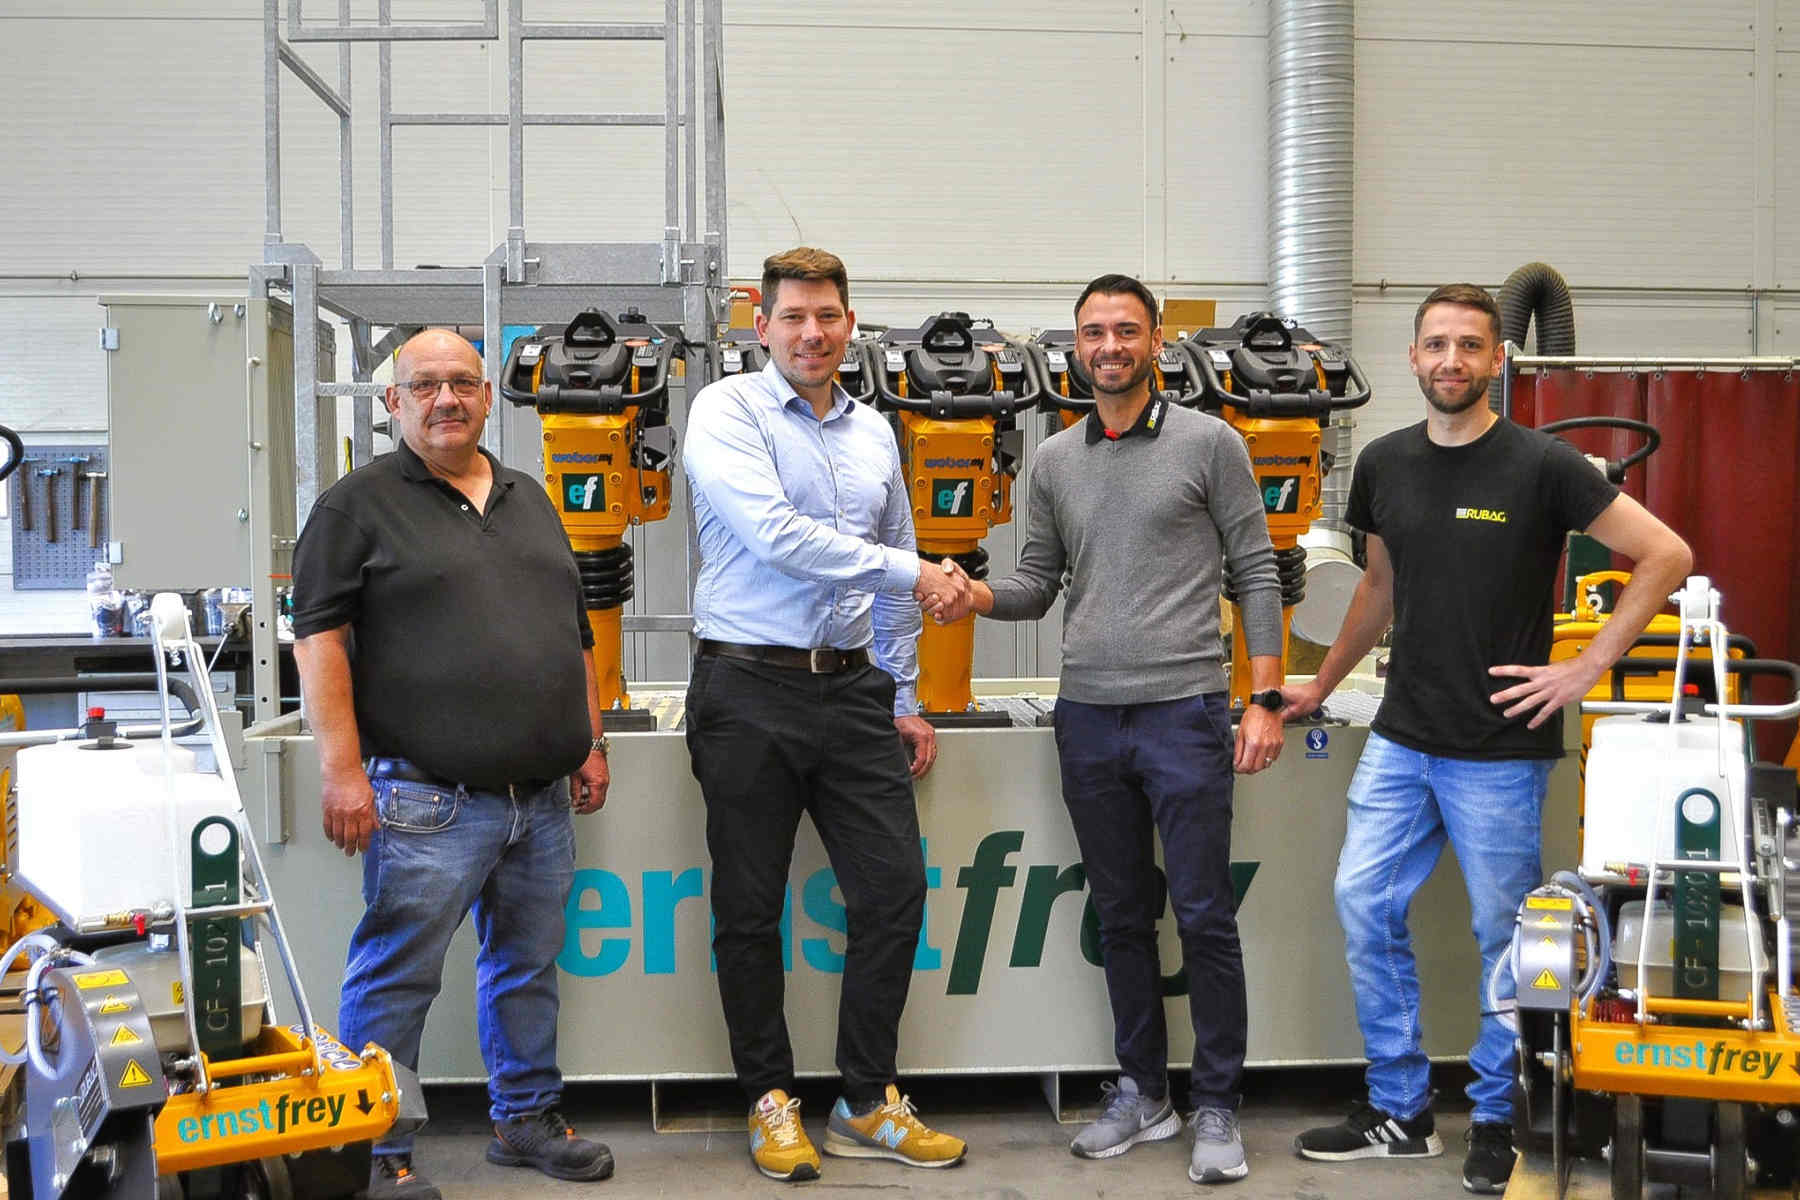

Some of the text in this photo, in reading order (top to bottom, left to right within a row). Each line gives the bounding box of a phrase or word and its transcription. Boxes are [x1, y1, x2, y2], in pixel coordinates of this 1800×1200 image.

[569, 475, 598, 510] ef
[938, 481, 968, 515] ef
[1264, 478, 1295, 511] ef
[1466, 508, 1506, 522] RUBAG
